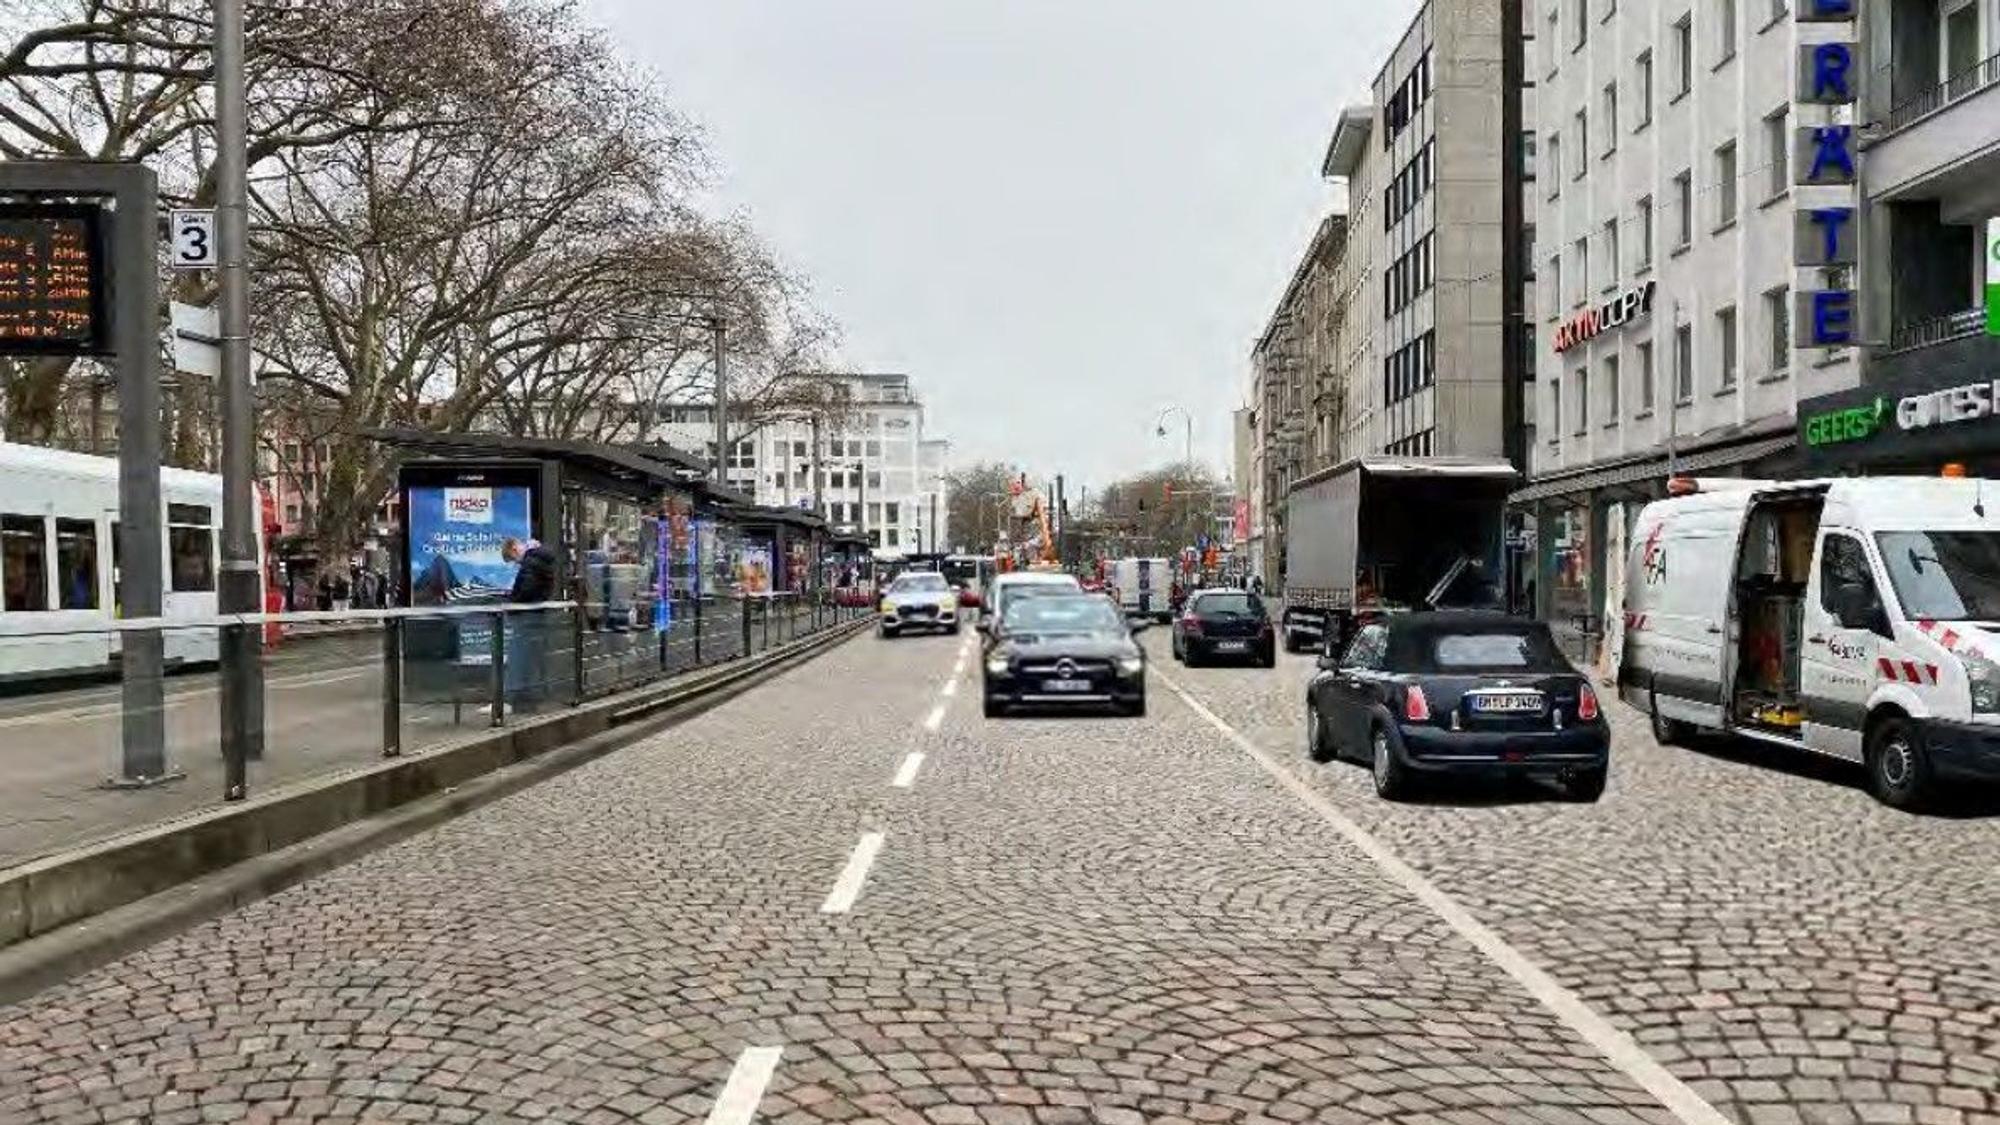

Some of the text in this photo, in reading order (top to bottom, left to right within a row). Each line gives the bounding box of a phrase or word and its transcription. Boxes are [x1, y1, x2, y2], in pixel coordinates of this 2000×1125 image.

[1808, 0, 1854, 343] RÄTE
[181, 226, 208, 261] 3
[1807, 407, 1868, 445] GEERS
